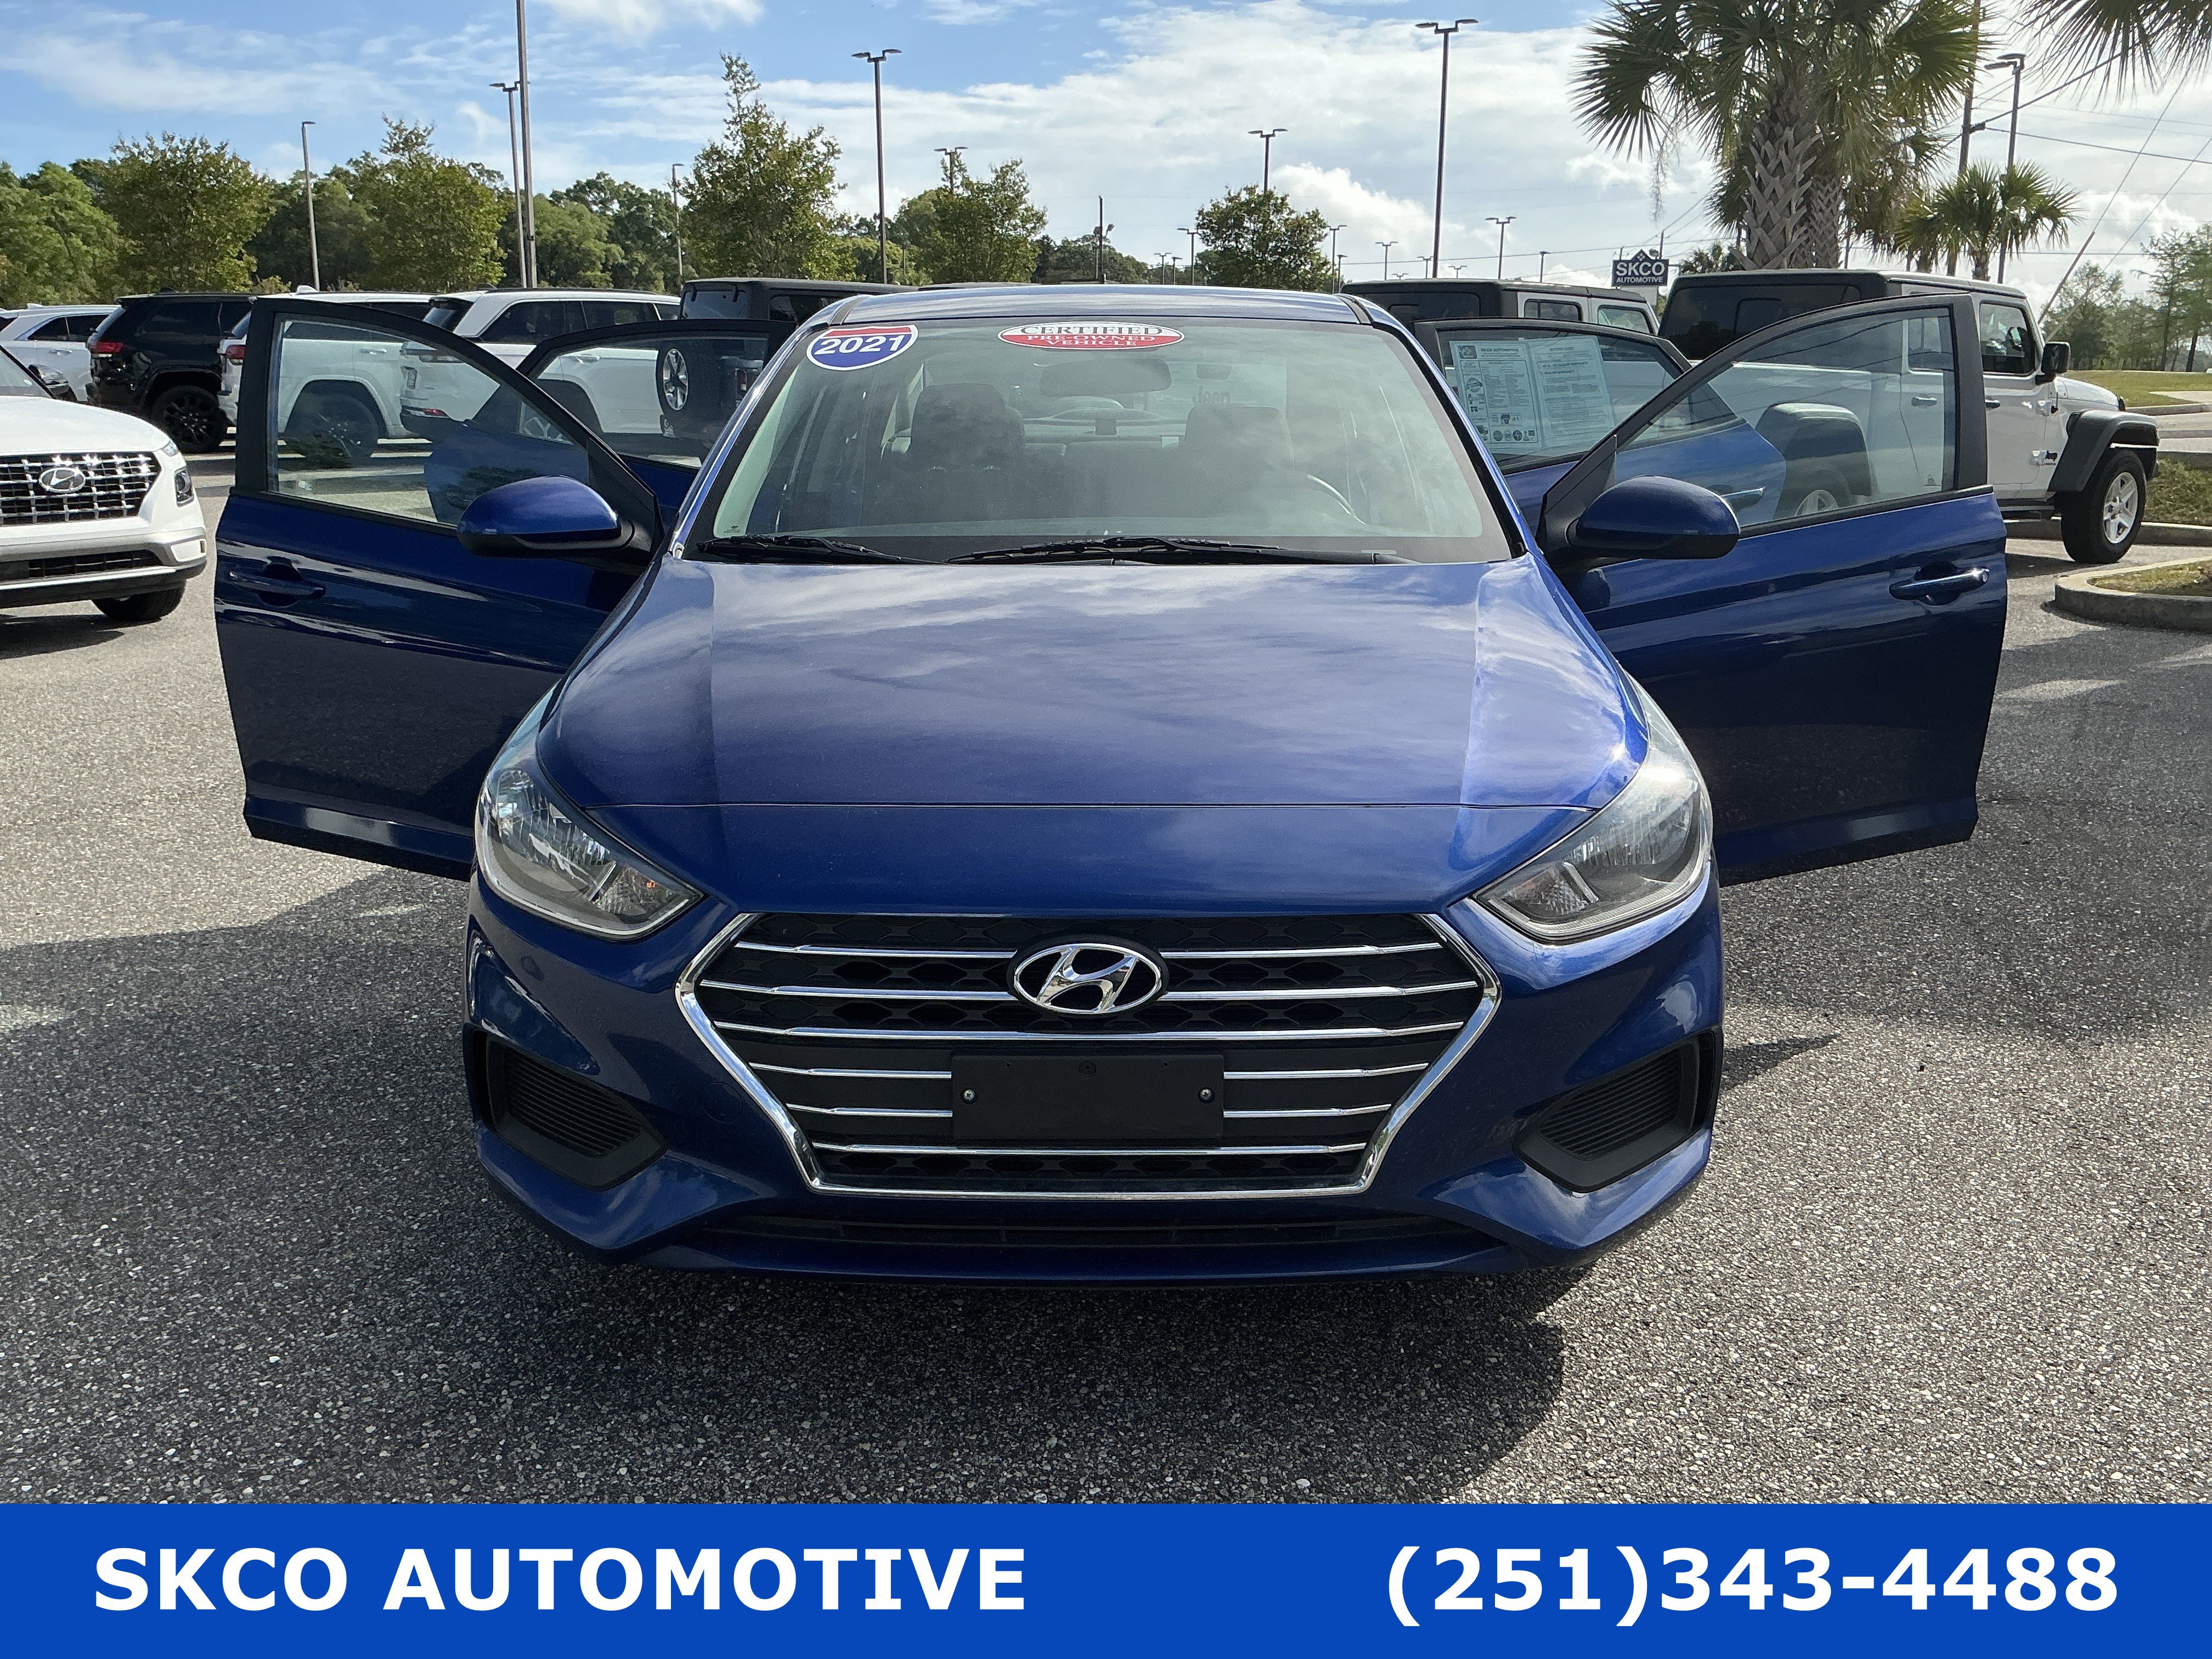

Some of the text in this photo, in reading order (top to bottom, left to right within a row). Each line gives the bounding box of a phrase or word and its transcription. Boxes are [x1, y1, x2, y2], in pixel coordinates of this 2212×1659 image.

[1616, 262, 1665, 276] SKCO
[1020, 326, 1163, 335] CERTIFIED
[814, 334, 905, 356] 2021
